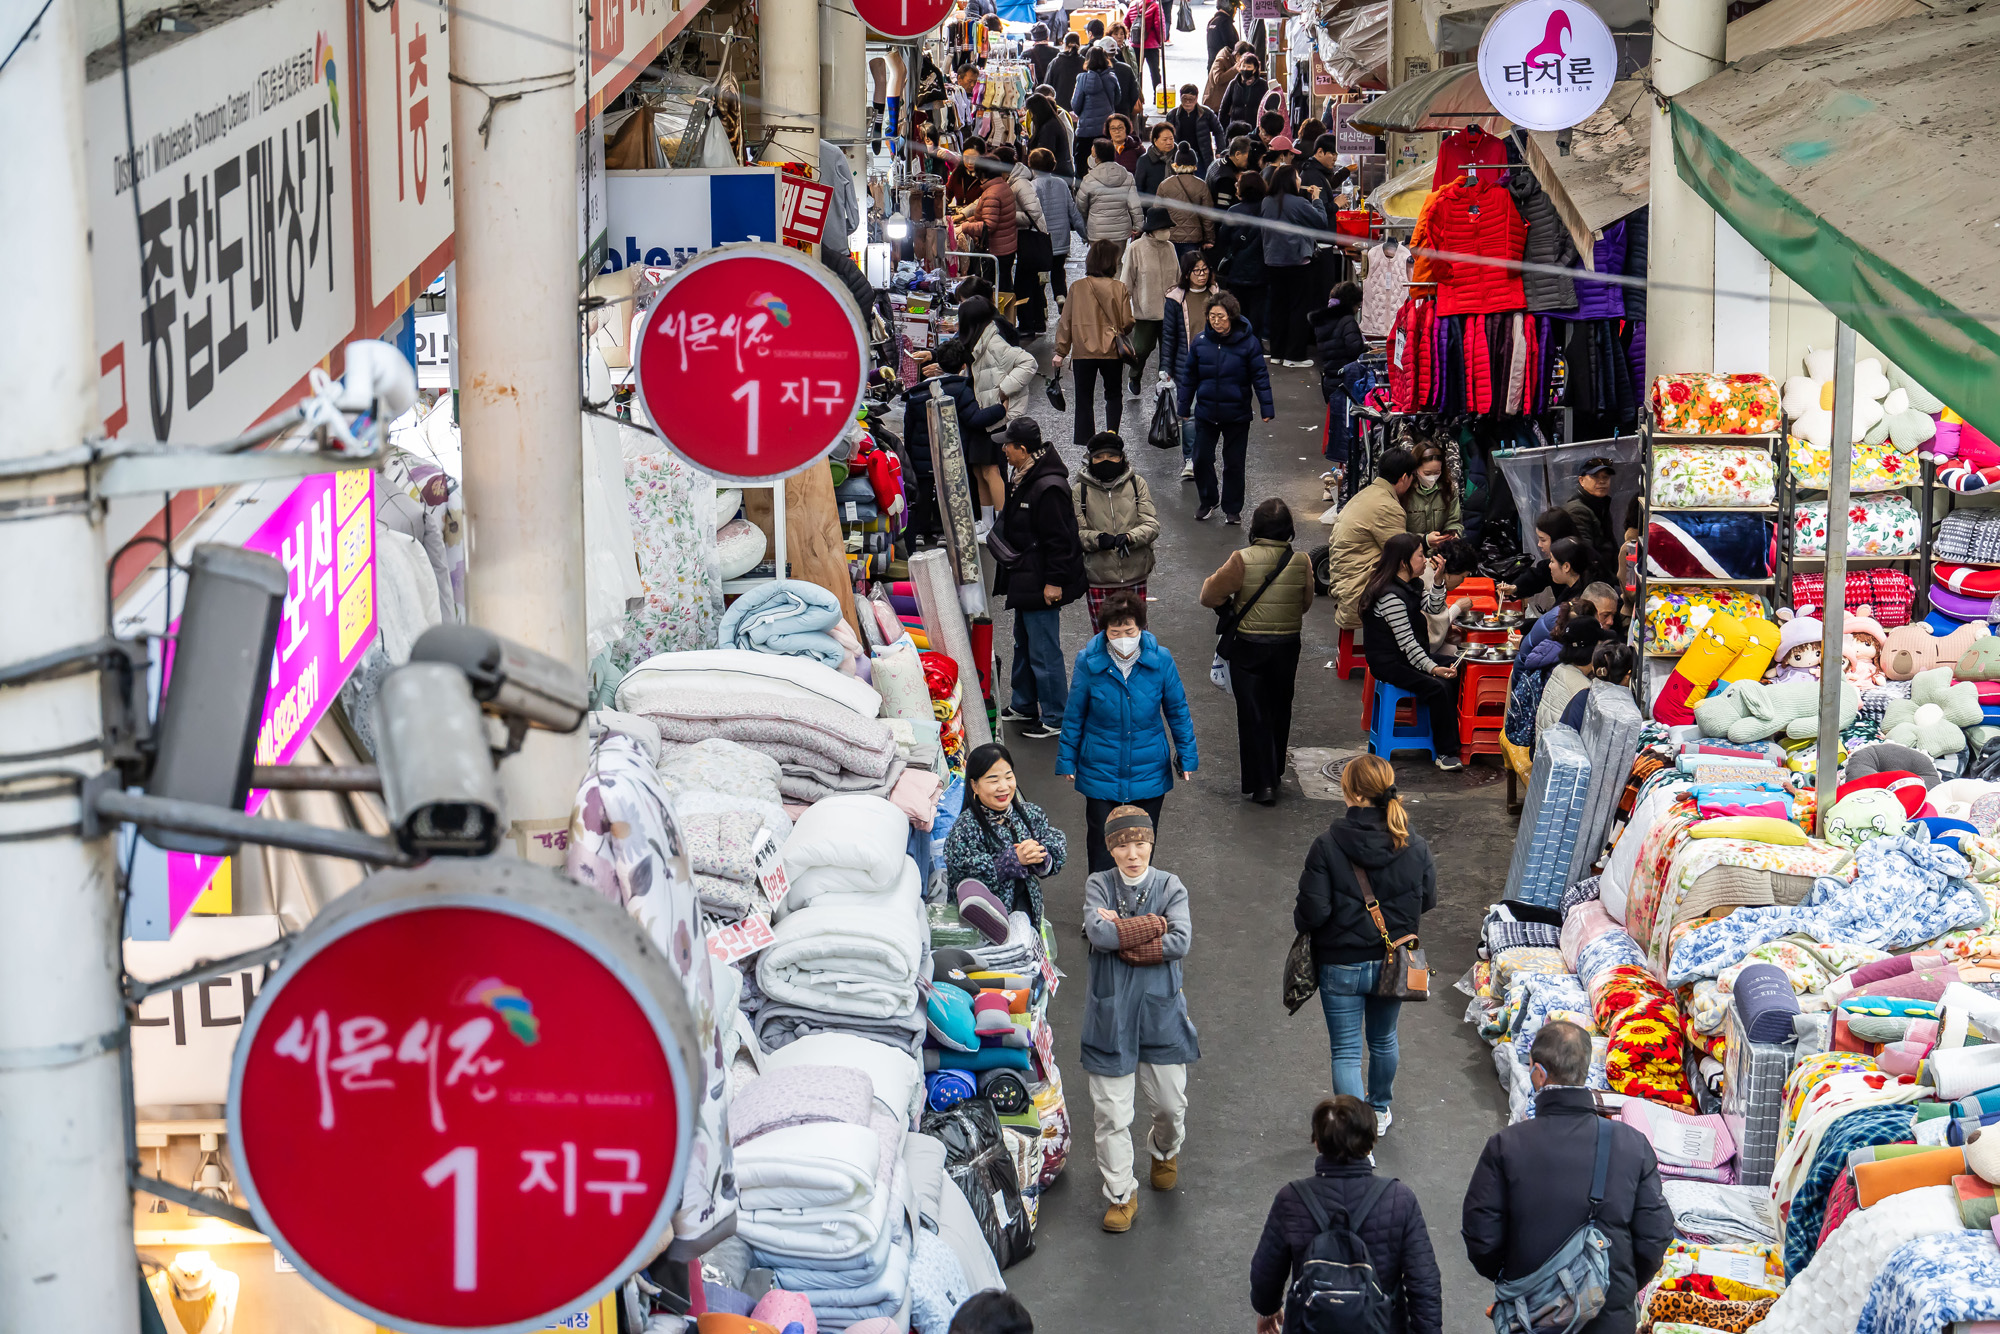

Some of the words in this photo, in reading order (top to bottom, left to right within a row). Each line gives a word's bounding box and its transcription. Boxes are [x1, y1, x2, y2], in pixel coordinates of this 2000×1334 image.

[1502, 57, 1595, 89] 타치론
[152, 122, 192, 173] Wholesale
[195, 103, 227, 150] Shopping
[228, 90, 250, 131] Center
[140, 103, 334, 443] 종합도매상가
[658, 310, 773, 373] 서문시장
[731, 380, 760, 456] 1
[780, 377, 844, 416] 지구
[763, 863, 789, 903] 3만원
[275, 1010, 504, 1133] 서문시장
[422, 1146, 478, 1291] 1
[519, 1141, 648, 1216] 지구
